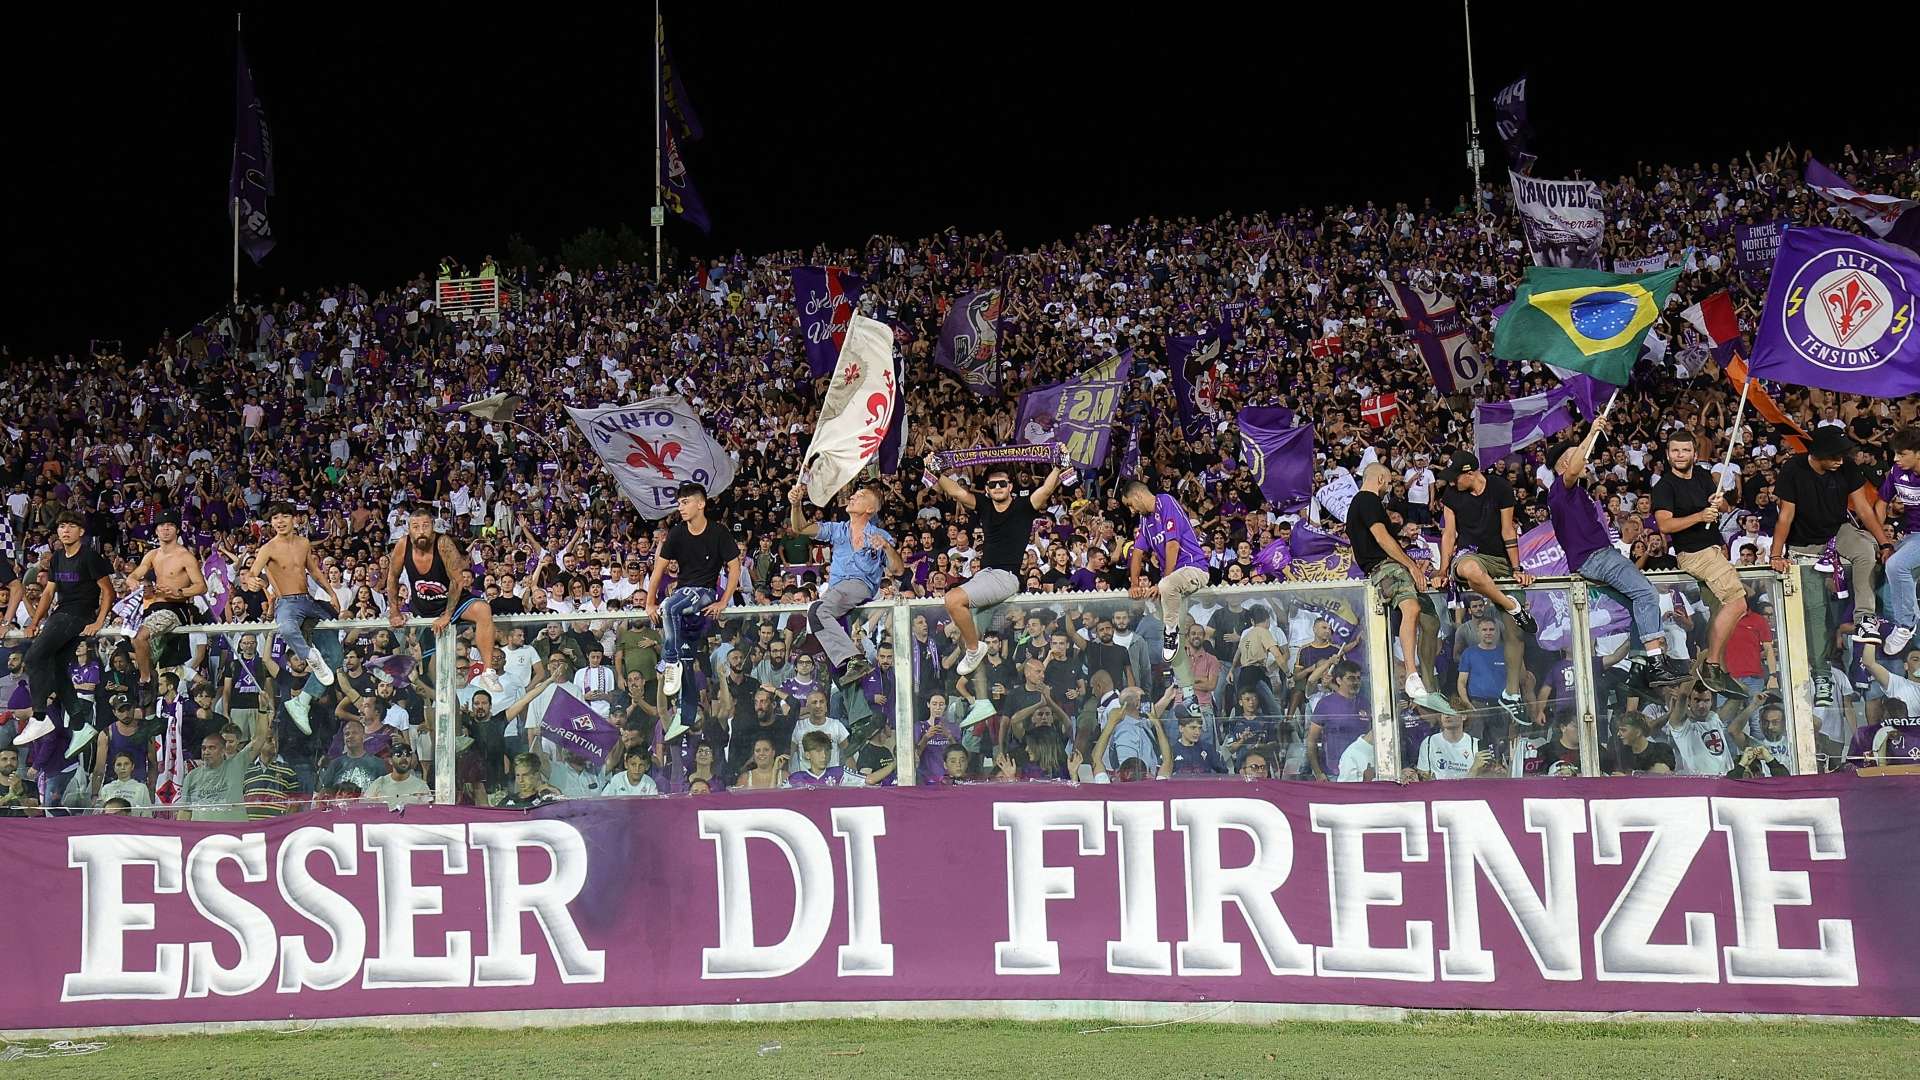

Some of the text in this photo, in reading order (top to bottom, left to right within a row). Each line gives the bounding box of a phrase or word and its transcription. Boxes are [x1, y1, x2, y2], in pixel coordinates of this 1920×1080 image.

[1741, 235, 1783, 251] MORTE NO
[1746, 250, 1755, 262] CI
[1836, 254, 1880, 275] ALTA
[1800, 334, 1880, 366] TENSIONE
[652, 468, 709, 506] 199
[1564, 670, 1574, 687] 9
[61, 796, 1860, 1001] ESSER DI FIRENZE
